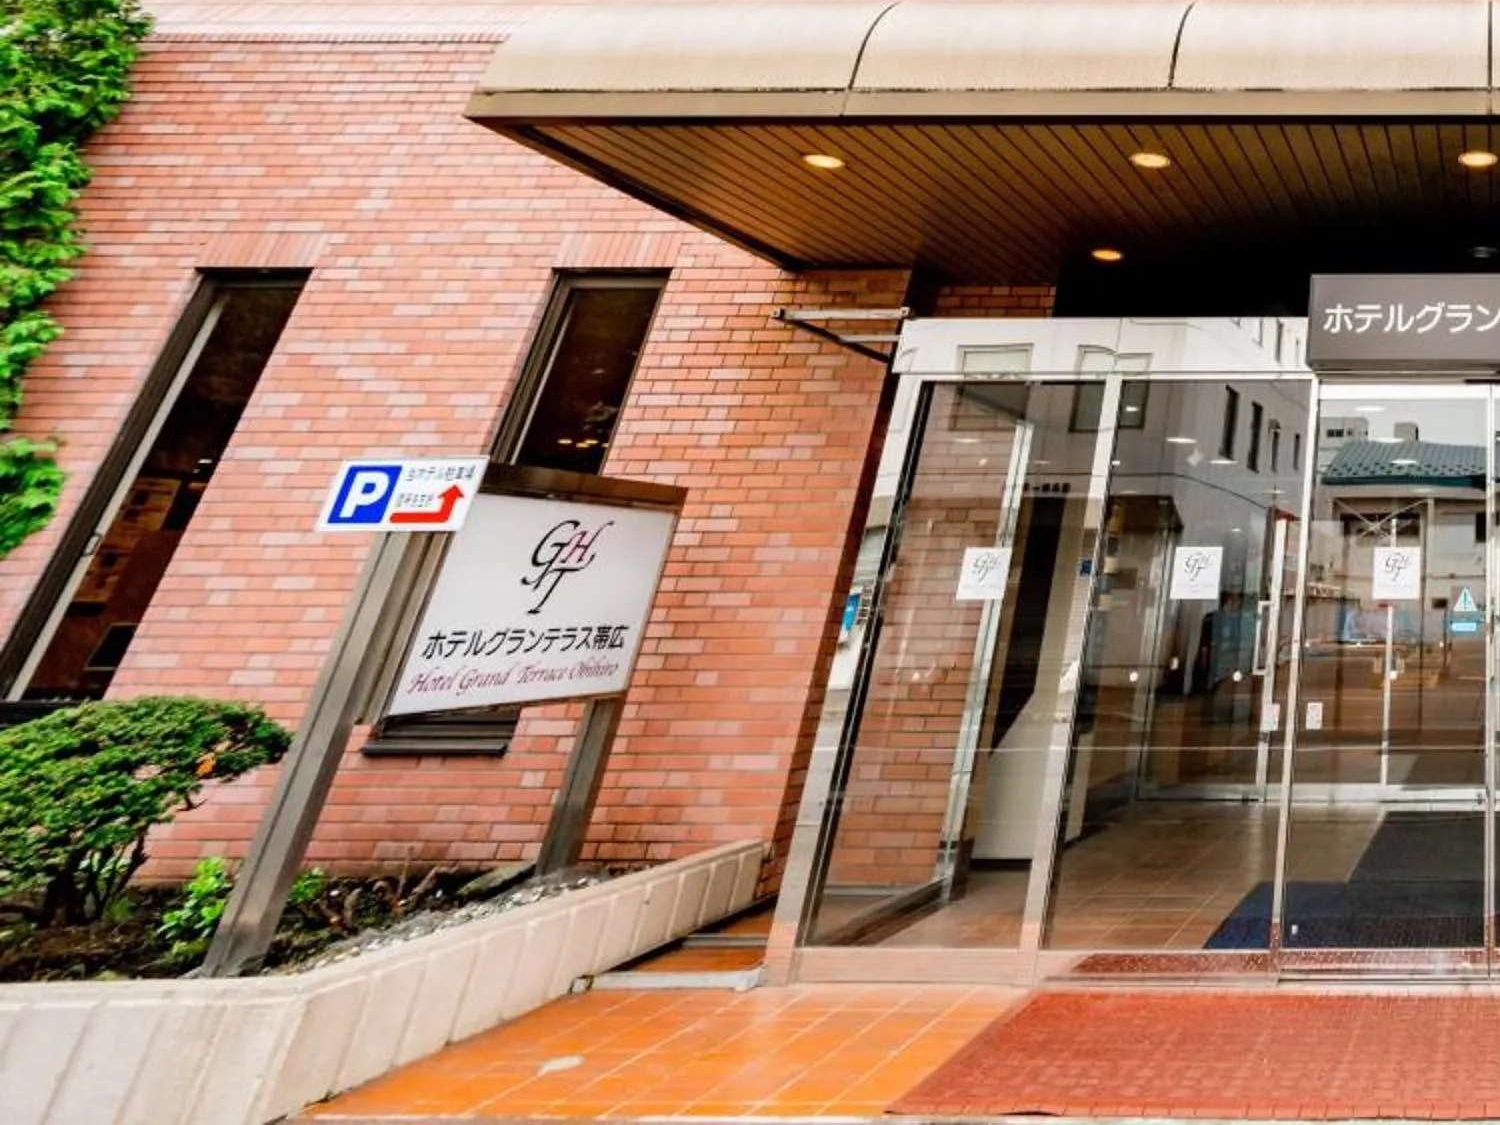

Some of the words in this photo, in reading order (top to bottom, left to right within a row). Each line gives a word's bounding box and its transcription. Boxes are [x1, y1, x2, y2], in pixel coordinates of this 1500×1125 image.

[339, 472, 390, 519] P
[422, 625, 630, 660] ホテルグランテラス帯広
[408, 665, 458, 694] Hotel
[456, 663, 515, 696] Grand
